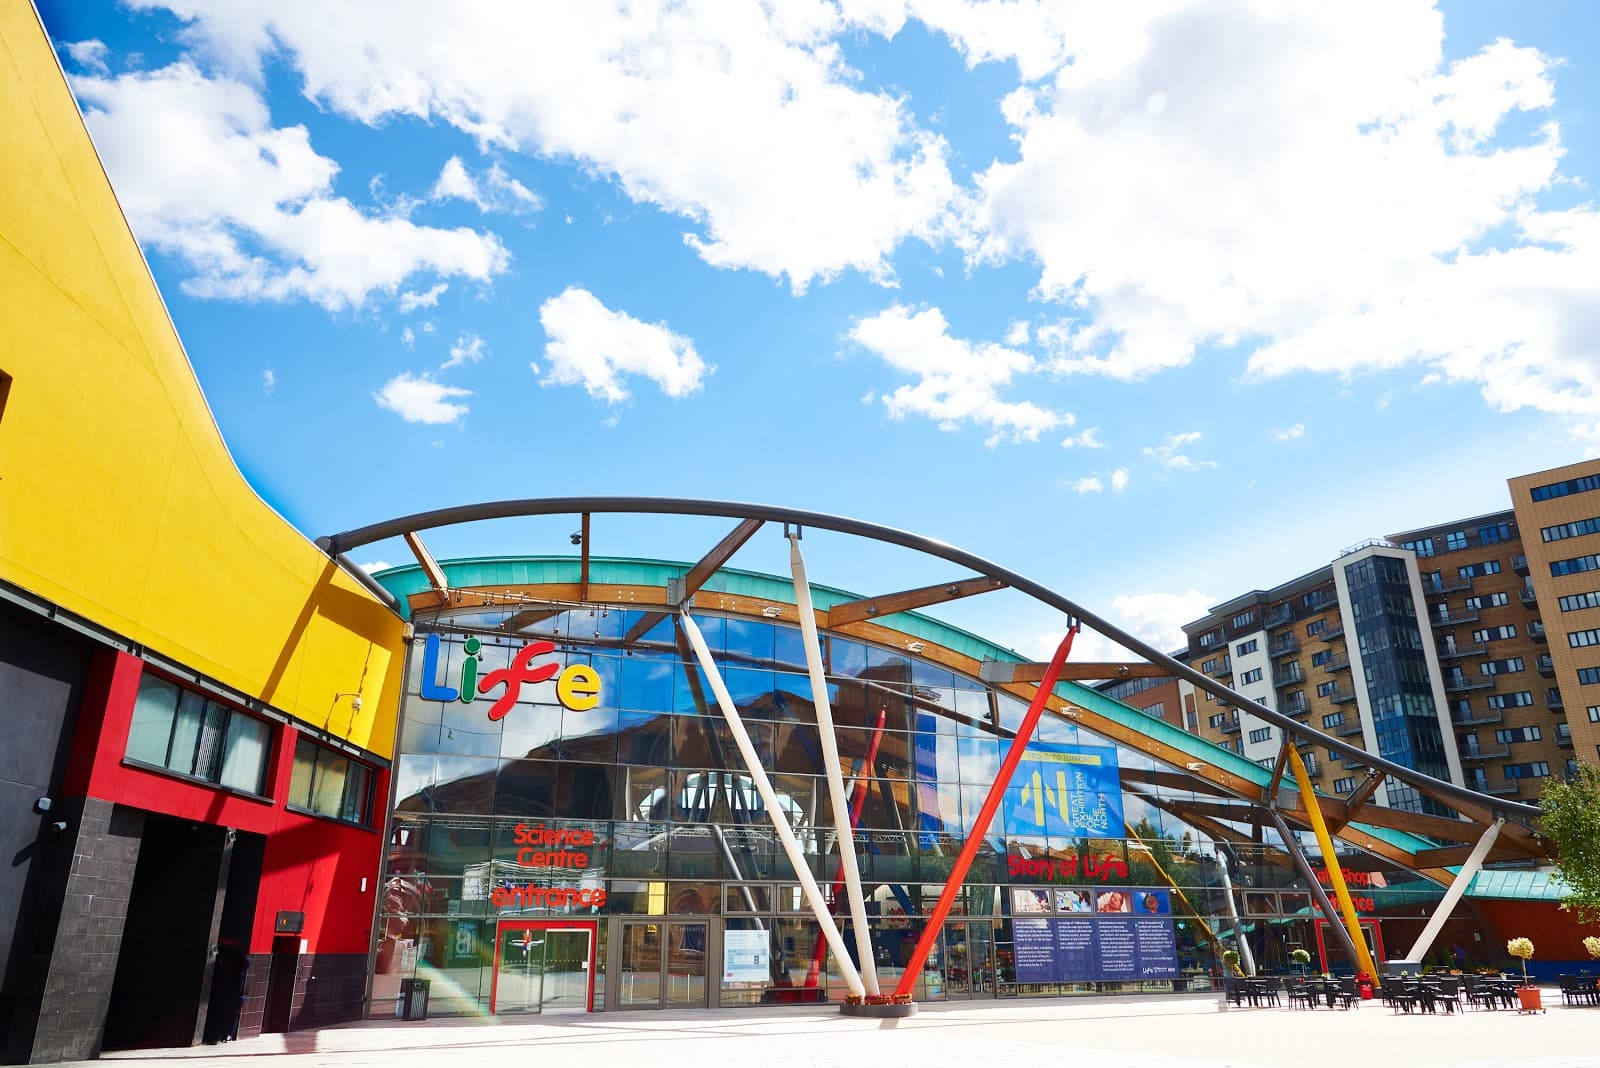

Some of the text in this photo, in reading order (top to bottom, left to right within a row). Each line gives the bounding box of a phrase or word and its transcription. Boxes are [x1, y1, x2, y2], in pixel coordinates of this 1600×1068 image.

[420, 633, 602, 721] Life
[1070, 793, 1080, 827] GREAT
[1075, 772, 1086, 828] EXHIBITION
[1098, 792, 1108, 829] NORTH
[1085, 814, 1094, 828] OF
[1093, 808, 1101, 828] THE
[513, 823, 594, 846] Science
[516, 846, 589, 868] Centre
[1007, 853, 1128, 881] Story of Life
[490, 882, 607, 907] entrance
